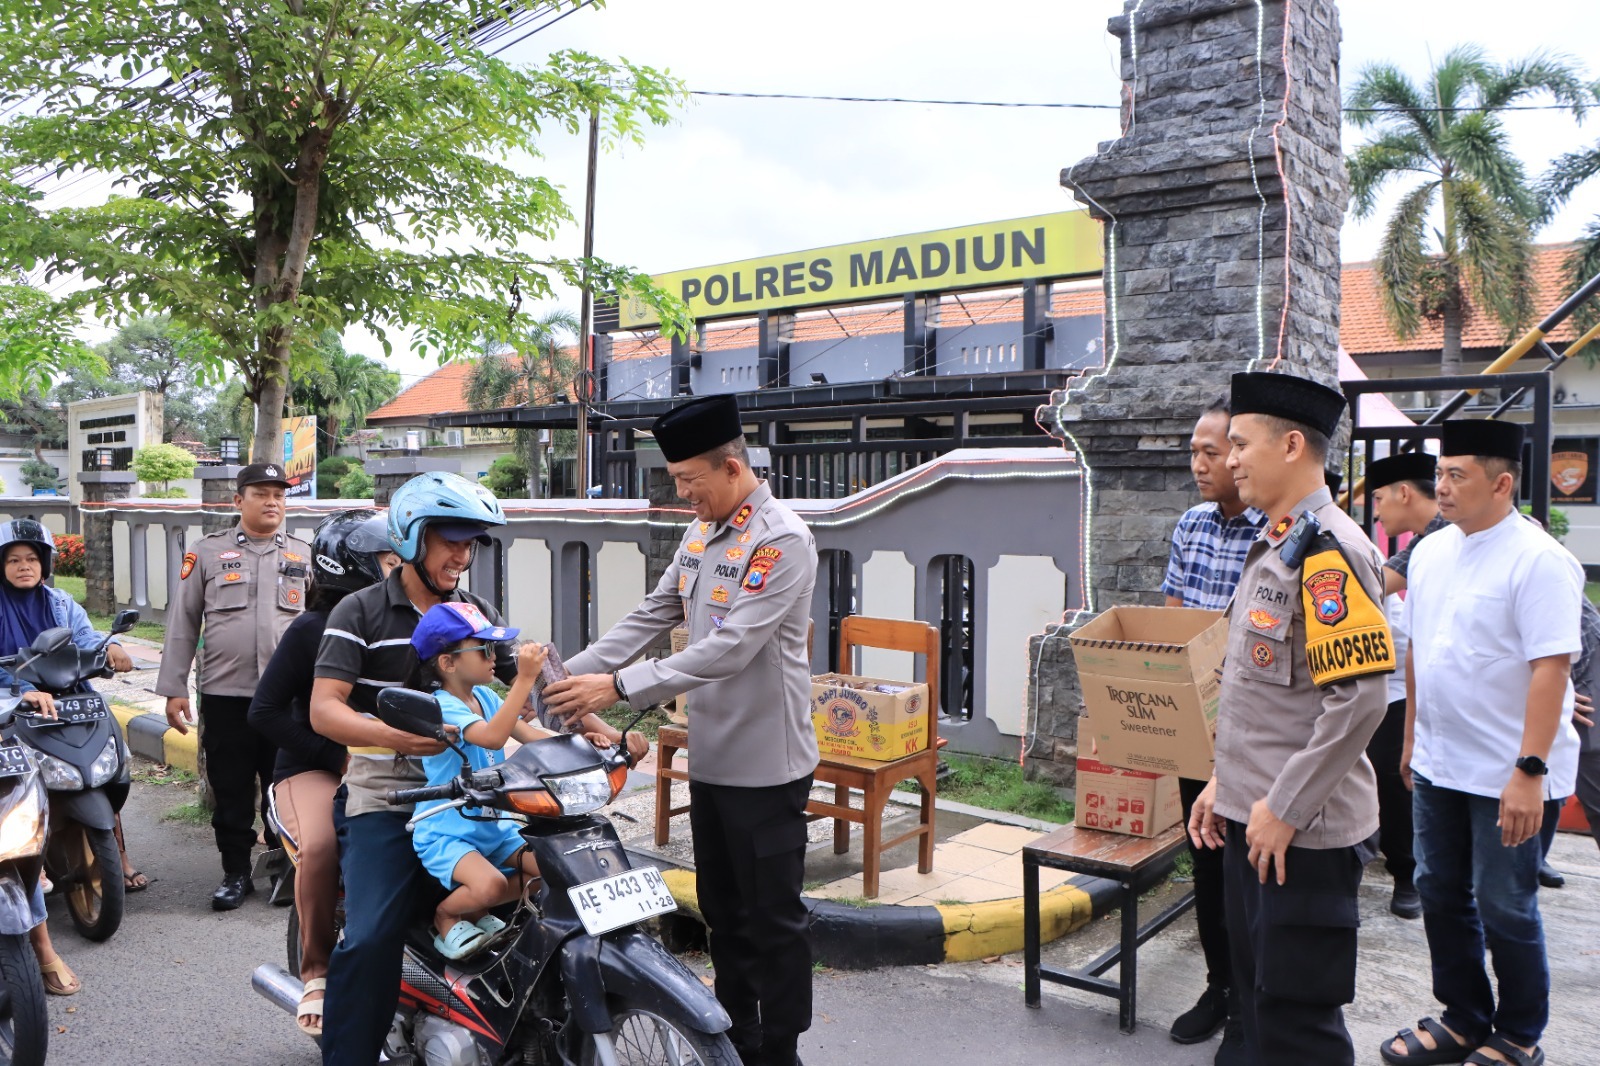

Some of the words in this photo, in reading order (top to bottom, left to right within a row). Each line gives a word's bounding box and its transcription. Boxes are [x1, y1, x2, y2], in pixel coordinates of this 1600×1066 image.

[682, 258, 833, 306] POLRES
[850, 227, 1046, 288] MADIUN
[222, 562, 241, 570] EKO
[714, 564, 739, 579] POLRI
[1256, 586, 1288, 605] POLRI
[818, 689, 837, 705] SAPI
[839, 688, 868, 711] JUMBO
[1106, 685, 1178, 711] TROPICANA
[1127, 705, 1156, 720] SLIM
[1120, 720, 1177, 737] Sweetener
[905, 737, 918, 754] KK
[578, 887, 601, 910] AE
[603, 876, 641, 900] 3433
